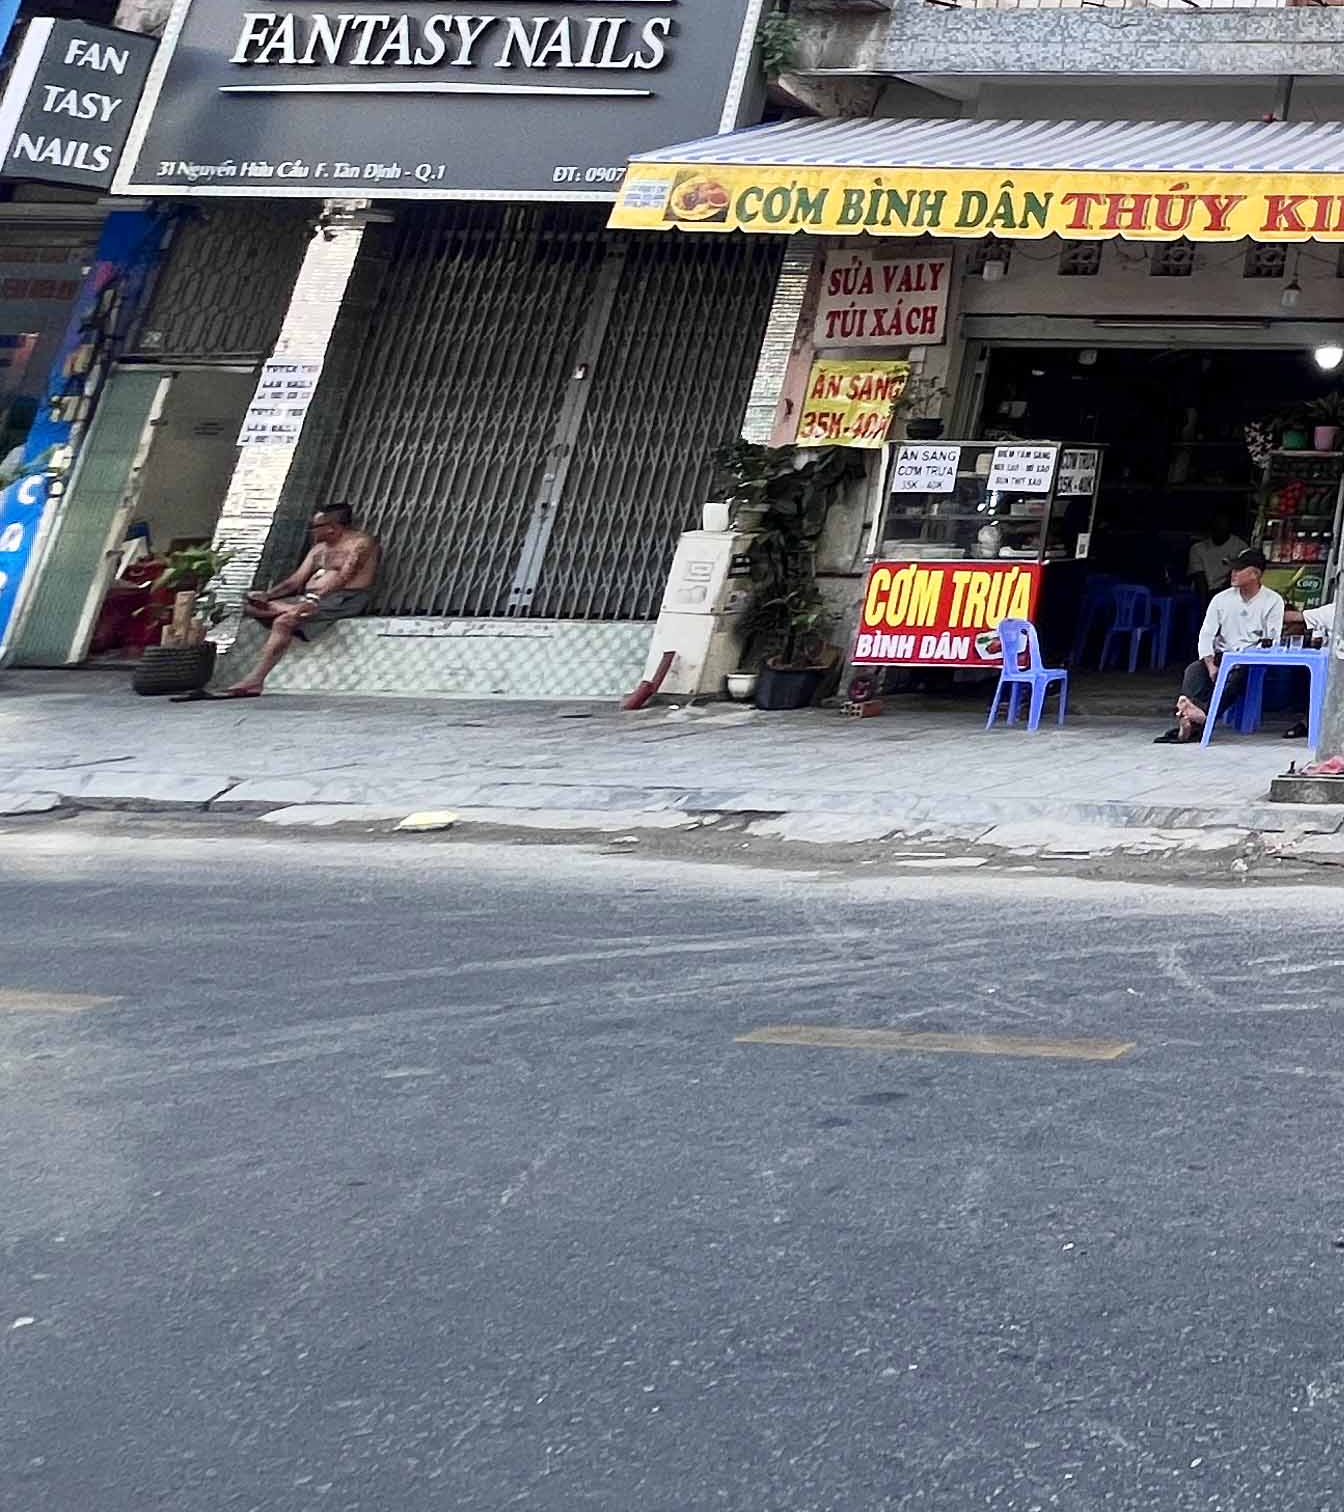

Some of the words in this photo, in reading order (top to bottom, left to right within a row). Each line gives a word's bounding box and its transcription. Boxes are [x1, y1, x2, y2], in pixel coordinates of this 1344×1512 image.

[63, 39, 131, 75] FAN
[229, 12, 500, 67] FANTASY
[494, 15, 672, 70] NAILS
[42, 85, 123, 122] TASY
[12, 133, 113, 172] NAILS
[414, 163, 446, 181] Q.1
[552, 166, 582, 182] ĐT:
[735, 180, 830, 224] CƠM
[836, 177, 948, 227] BÌNH
[954, 179, 1054, 229] DÂN
[1060, 182, 1249, 233] THÚY
[827, 255, 875, 296] SỬA
[882, 262, 945, 294] VALY
[825, 301, 868, 338] TÚI
[869, 298, 939, 337] XÁCH
[811, 369, 844, 400] ĂN
[846, 367, 905, 401] SÁNG
[863, 563, 946, 628] CƠM
[948, 564, 1033, 630] TRƯA
[855, 628, 916, 659] BÌNH
[918, 630, 971, 661] DÂN
